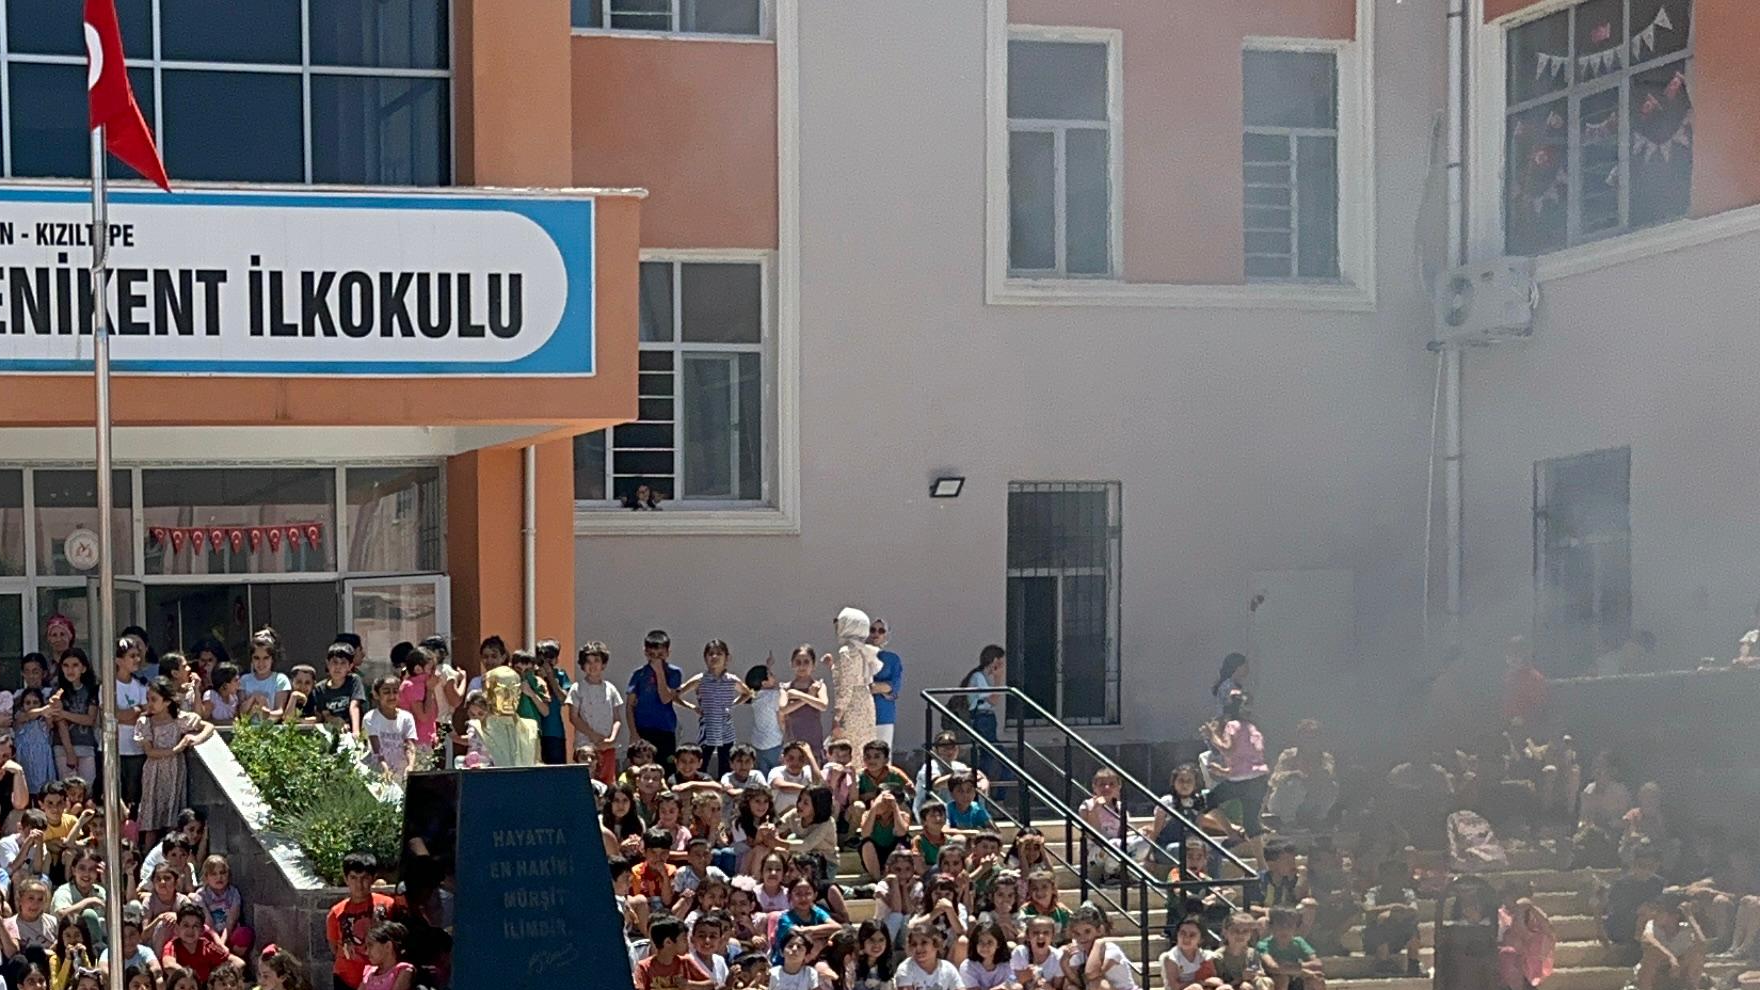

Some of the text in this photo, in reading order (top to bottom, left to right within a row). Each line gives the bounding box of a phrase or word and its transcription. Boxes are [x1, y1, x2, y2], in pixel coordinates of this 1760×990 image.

[36, 222, 135, 247] KIZILTPE
[249, 255, 523, 339] İLKOKULU
[493, 828, 567, 848] HAYATTA
[490, 861, 512, 879] EN
[503, 886, 570, 911] MÜRŞİT
